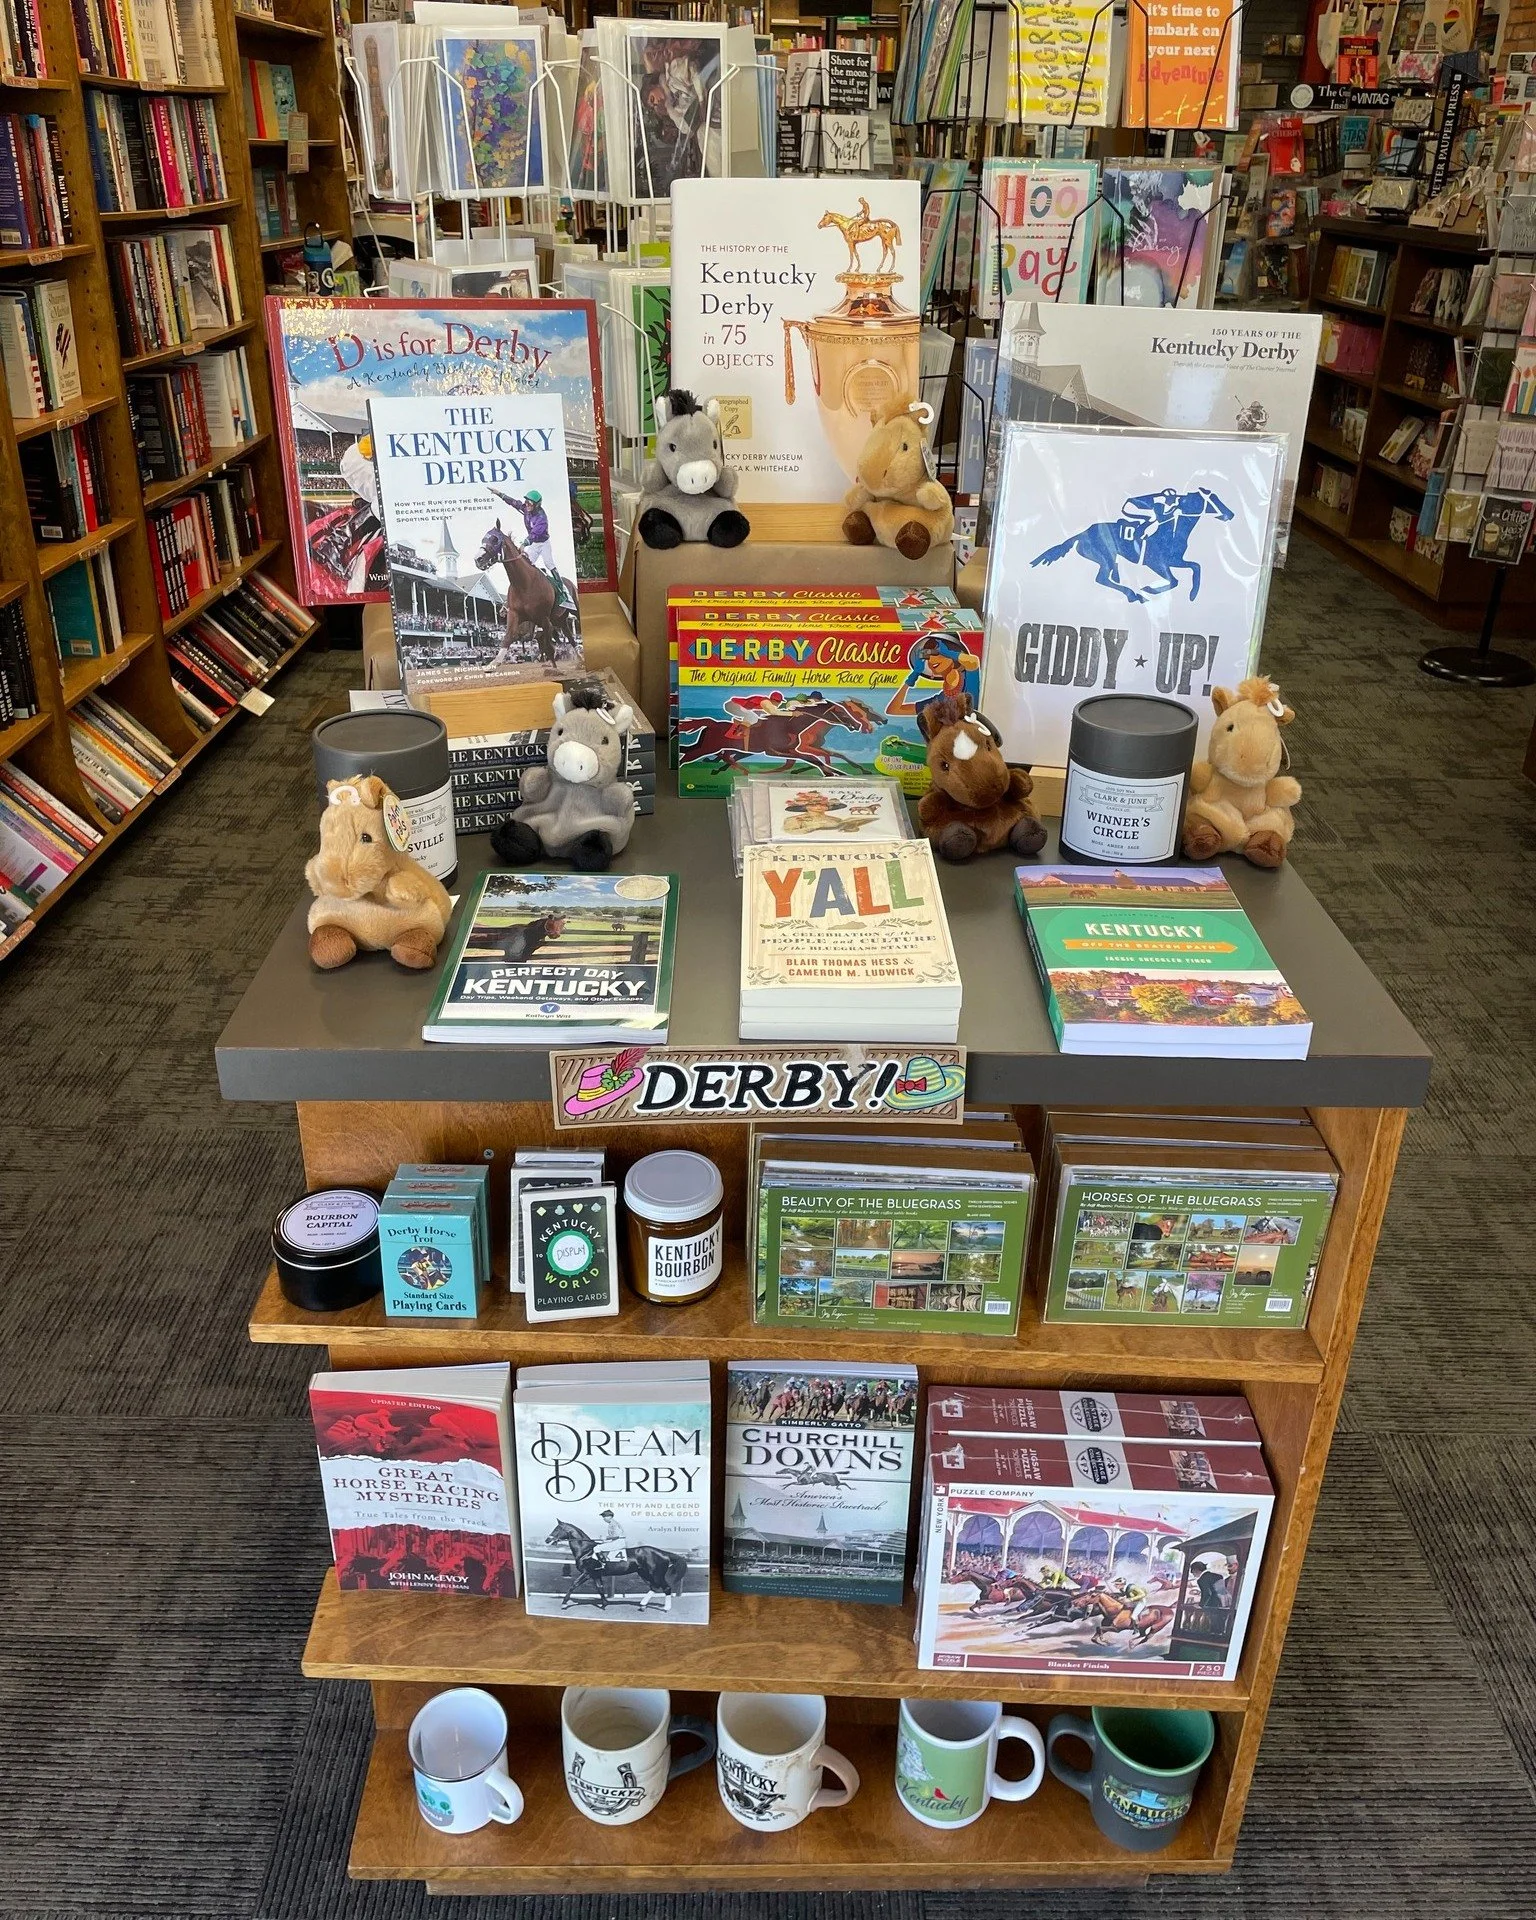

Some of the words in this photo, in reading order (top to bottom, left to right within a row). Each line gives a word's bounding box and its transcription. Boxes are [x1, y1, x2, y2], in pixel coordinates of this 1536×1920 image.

[1148, 6, 1168, 16] it's
[1172, 6, 1204, 16] time
[1207, 7, 1220, 16] to
[1148, 25, 1198, 36] embark
[1202, 28, 1220, 36] on
[830, 55, 854, 66] Shoot
[856, 55, 870, 66] for
[1148, 46, 1180, 58] your
[1184, 45, 1216, 56] next
[830, 68, 844, 76] the
[1447, 84, 1460, 116] PRESS
[832, 121, 860, 140] Make
[1438, 120, 1454, 160] PAUPER
[58, 175, 68, 196] Karl
[1432, 163, 1445, 196] PETER
[62, 197, 70, 218] Marx
[701, 245, 717, 253] THE
[700, 262, 817, 292] Kentucky
[700, 294, 774, 323] Derby
[703, 333, 714, 344] in
[721, 324, 747, 345] 75
[1212, 328, 1228, 336] 150
[1266, 330, 1278, 338] OF
[1281, 332, 1302, 340] THE
[325, 334, 364, 372] D
[373, 338, 394, 362] is
[400, 332, 436, 358] for
[442, 322, 552, 378] Derby
[1151, 337, 1238, 361] Kentucky
[1242, 342, 1300, 364] Derby
[702, 354, 774, 370] OBJECTS
[444, 408, 494, 426] THE
[387, 427, 556, 458] KENTUCKY
[422, 458, 527, 486] DERBY
[395, 508, 423, 516] BECAME
[396, 516, 429, 524] SPORTING
[431, 514, 453, 522] EVENT
[696, 638, 810, 662] DERBY
[816, 636, 901, 665] Classic
[1014, 623, 1129, 690] GIDDY
[1155, 632, 1220, 696] UP!
[690, 670, 706, 682] The
[712, 669, 757, 686] Original
[762, 670, 796, 686] Family
[802, 670, 831, 684] Horse
[836, 670, 864, 684] Race
[868, 673, 898, 689] Game
[1086, 810, 1150, 828] WINNER'S
[1093, 826, 1140, 840] CIRCLE
[762, 860, 925, 918] Y'ALL
[1084, 922, 1204, 938] KENTUCKY
[786, 958, 818, 966] BLAIR
[822, 958, 866, 966] THOMAS
[871, 958, 898, 966] HESS
[491, 966, 578, 979] PERFECT
[584, 968, 625, 980] DAY
[788, 968, 842, 977] CAMERON
[846, 968, 861, 978] M.
[865, 967, 915, 976] LUDWICK
[462, 978, 646, 997] KENTUCKY
[634, 1062, 902, 1110] DERBY!
[782, 1196, 832, 1208] BEAUTY
[836, 1198, 854, 1208] OF
[858, 1198, 884, 1208] THE
[887, 1199, 962, 1210] BLUEGRASS
[1082, 1192, 1134, 1203] HORSES
[1137, 1194, 1156, 1204] OF
[1159, 1194, 1185, 1205] THE
[1187, 1196, 1262, 1207] BLUEGRASS
[388, 1226, 420, 1238] Derby
[424, 1226, 456, 1238] Horse
[412, 1234, 434, 1243] Trot
[540, 1218, 602, 1243] KENTUCKY
[556, 1244, 586, 1261] DISPLAY
[655, 1226, 720, 1261] KENTUCKY
[656, 1249, 714, 1278] BOURBON
[544, 1267, 600, 1288] WORLD
[404, 1292, 437, 1300] Standard
[439, 1292, 454, 1300] Size
[538, 1296, 574, 1306] PLAYING
[577, 1292, 608, 1302] CARDS
[392, 1300, 433, 1312] Playing
[436, 1300, 467, 1312] Cards
[370, 1398, 406, 1406] UPDATED
[408, 1402, 441, 1410] EDITION
[782, 1420, 828, 1428] KIMBERLY
[531, 1422, 702, 1466] DREAM
[742, 1428, 904, 1449] CHURCHILL
[742, 1445, 901, 1471] DOWNS
[378, 1467, 452, 1482] GREAT
[545, 1458, 702, 1502] DERBY
[333, 1478, 406, 1490] HORSE
[416, 1482, 500, 1502] RACING
[790, 1490, 844, 1500] America's
[950, 1488, 986, 1496] PUZZLE
[988, 1490, 1035, 1498] COMPANY
[356, 1491, 482, 1510] MYSTERIES
[750, 1497, 780, 1506] Most
[782, 1498, 828, 1510] Historic
[832, 1500, 888, 1511] Racetrack
[936, 1498, 944, 1517] YORK
[383, 1512, 408, 1520] Tales
[412, 1512, 436, 1522] from
[460, 1517, 488, 1527] Track
[388, 1572, 421, 1582] JOHN
[424, 1574, 468, 1584] McEVOY
[1048, 1661, 1080, 1670] Blanket
[1082, 1662, 1110, 1670] Finish
[718, 1750, 778, 1792] KENTUCKY
[573, 1778, 636, 1798] KENTUCKY
[900, 1782, 966, 1812] Kentucky
